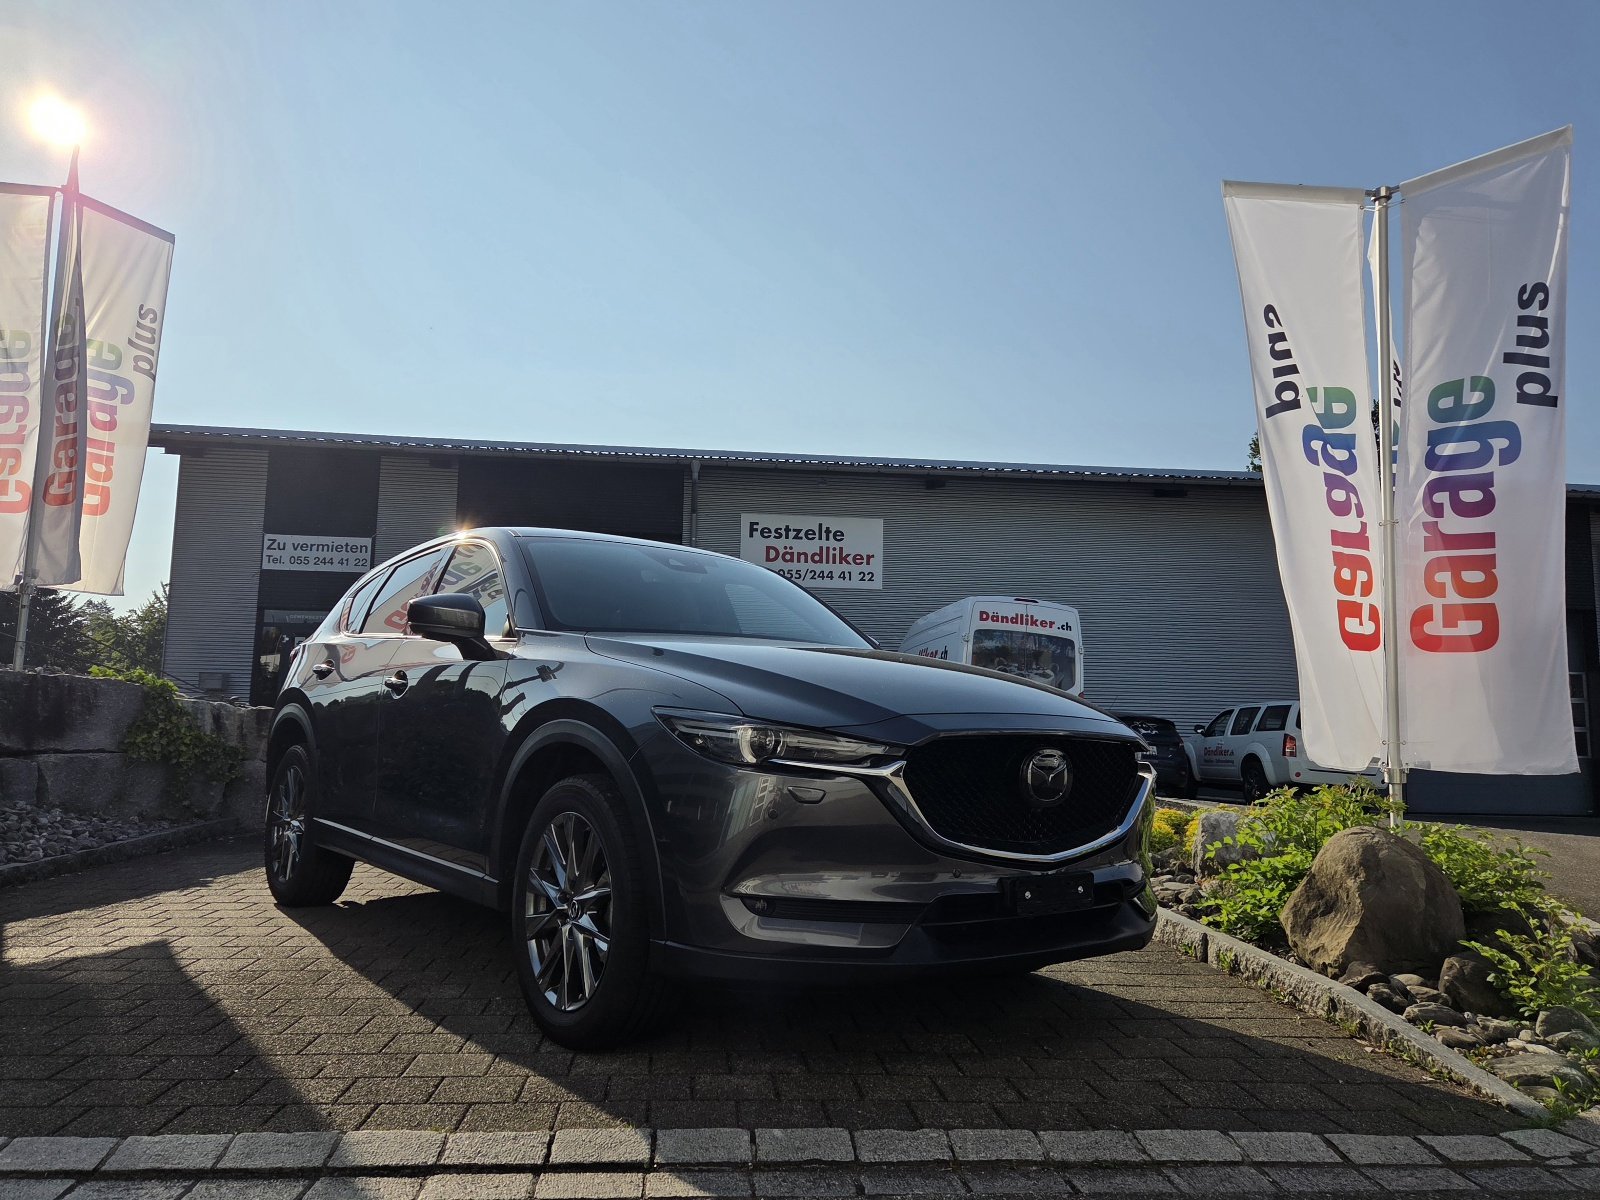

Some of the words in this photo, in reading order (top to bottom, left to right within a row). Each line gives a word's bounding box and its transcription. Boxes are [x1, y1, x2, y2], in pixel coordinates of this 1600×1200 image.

[127, 303, 158, 382] plus
[1502, 281, 1558, 408] plus
[1409, 375, 1522, 653] Garage
[748, 521, 845, 542] Festzelte
[266, 538, 286, 551] Zu
[291, 541, 368, 554] vermieten
[765, 545, 875, 566] Dändliker
[265, 554, 285, 565] Tel.
[289, 555, 310, 565] 055
[313, 556, 334, 566] 244
[337, 557, 349, 567] 41
[353, 558, 368, 567] 22
[838, 570, 852, 582] 41
[858, 571, 875, 582] 22
